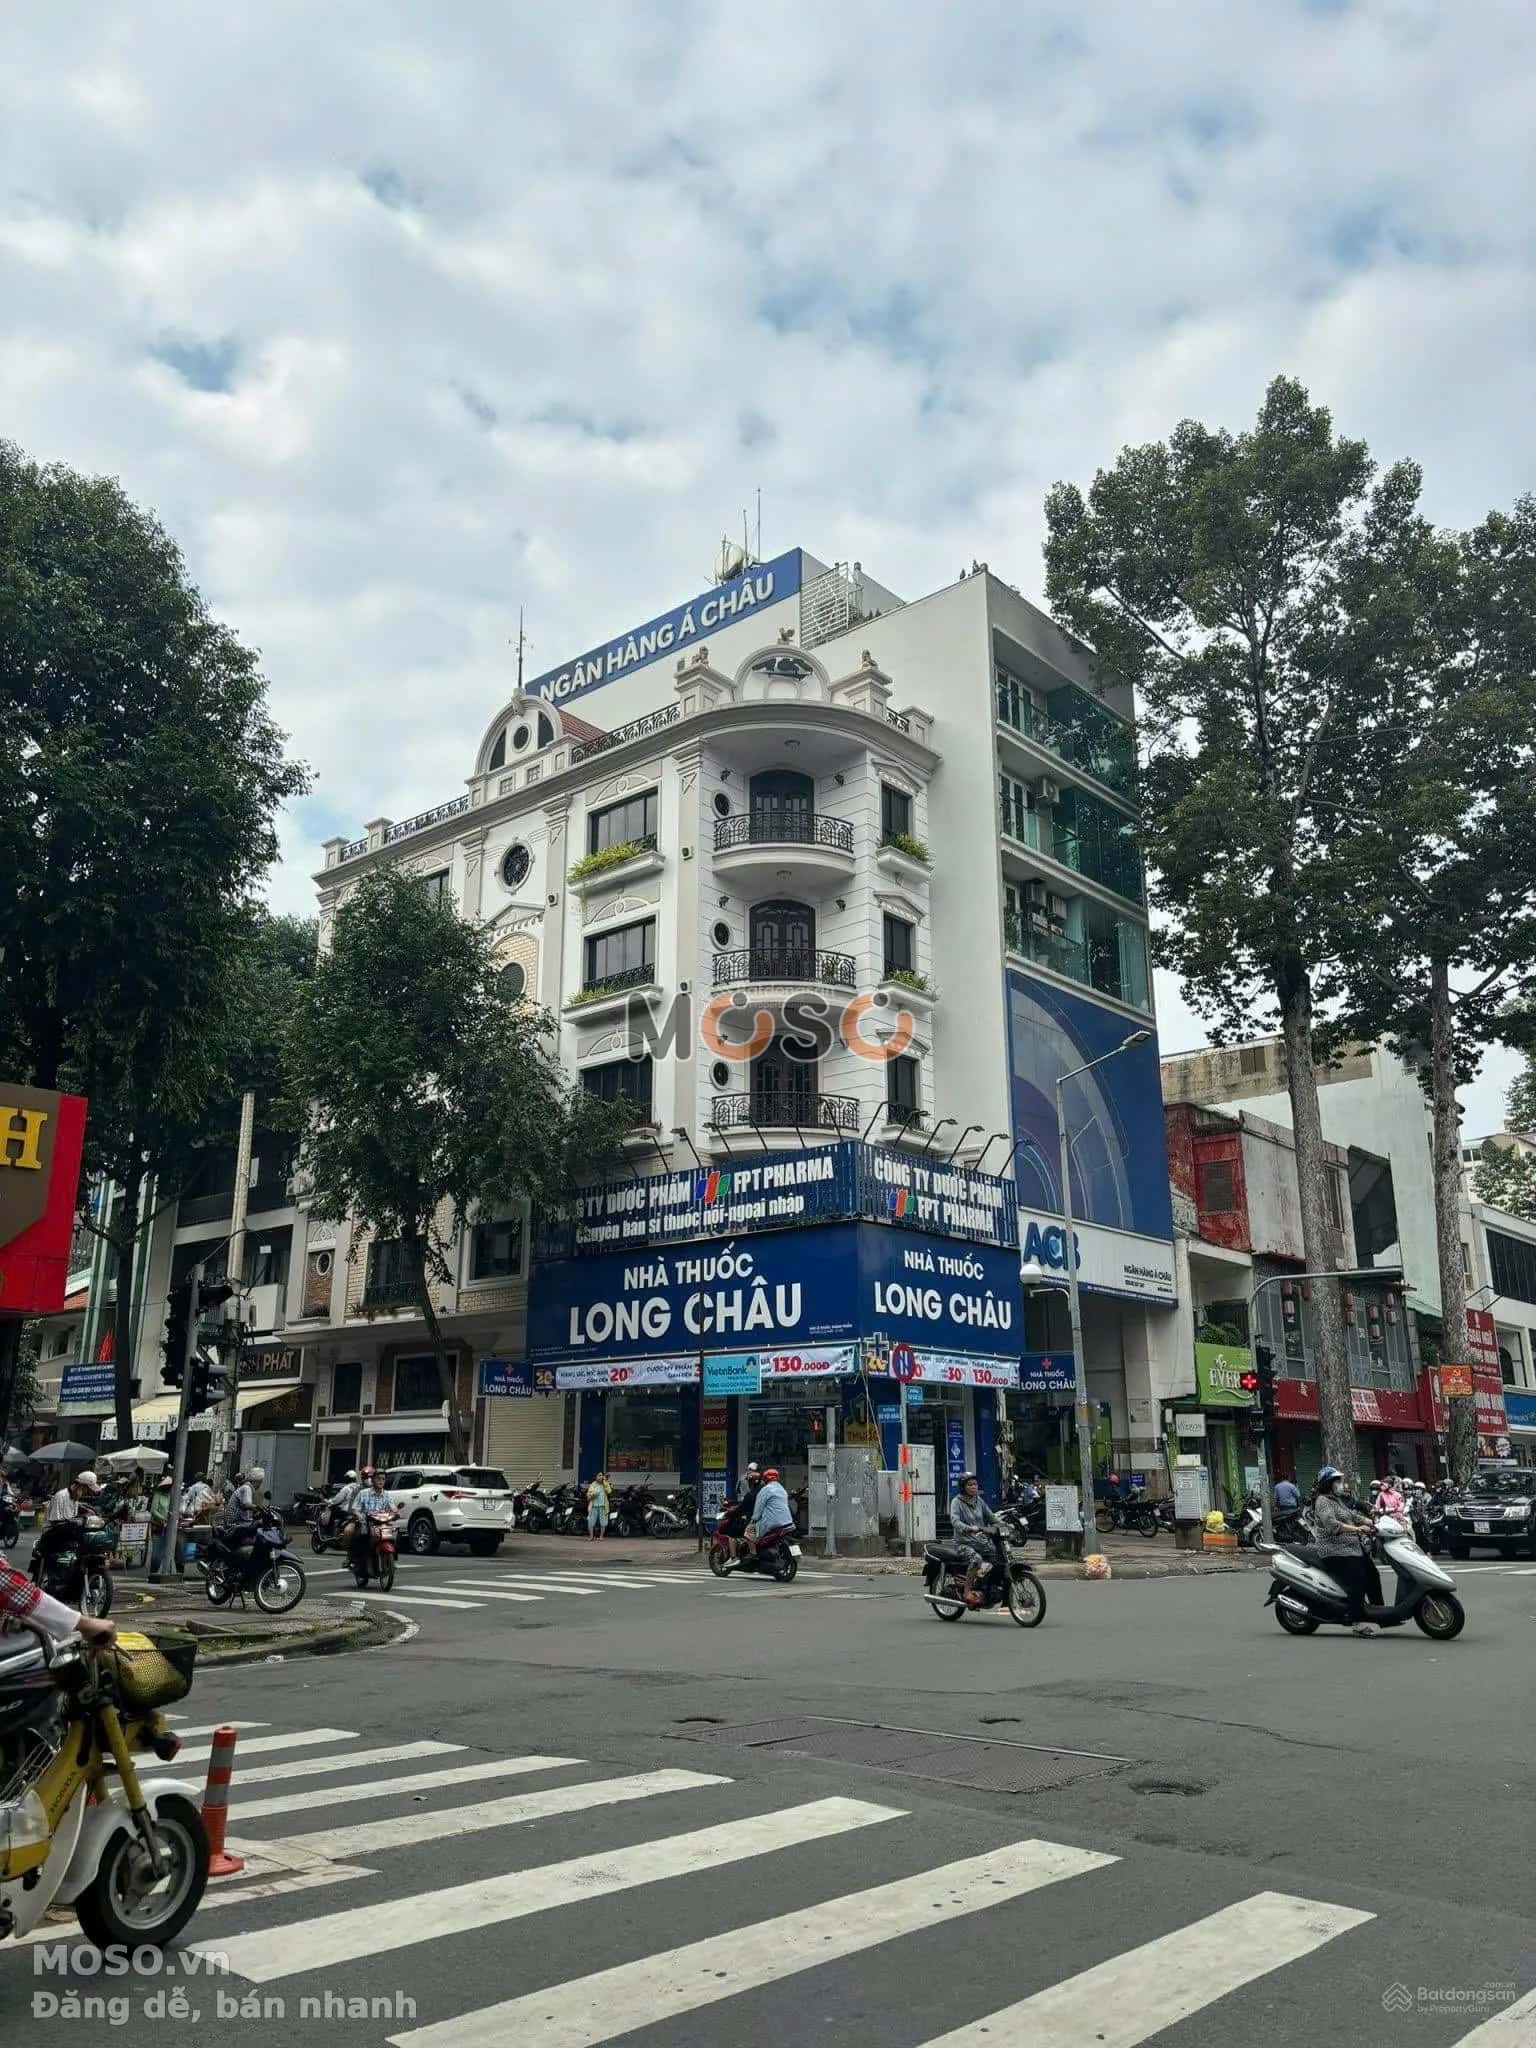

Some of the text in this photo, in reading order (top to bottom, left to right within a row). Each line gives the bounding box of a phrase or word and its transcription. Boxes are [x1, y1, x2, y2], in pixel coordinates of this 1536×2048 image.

[540, 570, 774, 702] NGÂN HÀNG Á CHÂU
[585, 1195, 604, 1217] TY
[606, 1187, 647, 1215] DƯỢC
[733, 1171, 762, 1193] FPT
[765, 1156, 834, 1189] PHARMA
[874, 1154, 1003, 1208] CÔNG TY DƯỢC PHẨM
[916, 1196, 994, 1233] FPT PHARMA
[624, 1241, 754, 1291] NHÀ THUỐC
[904, 1249, 985, 1281] NHÀ THUỐC
[570, 1275, 802, 1345] LONG CHÂU
[874, 1281, 1012, 1330] LONG CHÂU
[485, 1384, 507, 1393] LONG
[1021, 1382, 1047, 1390] LONG
